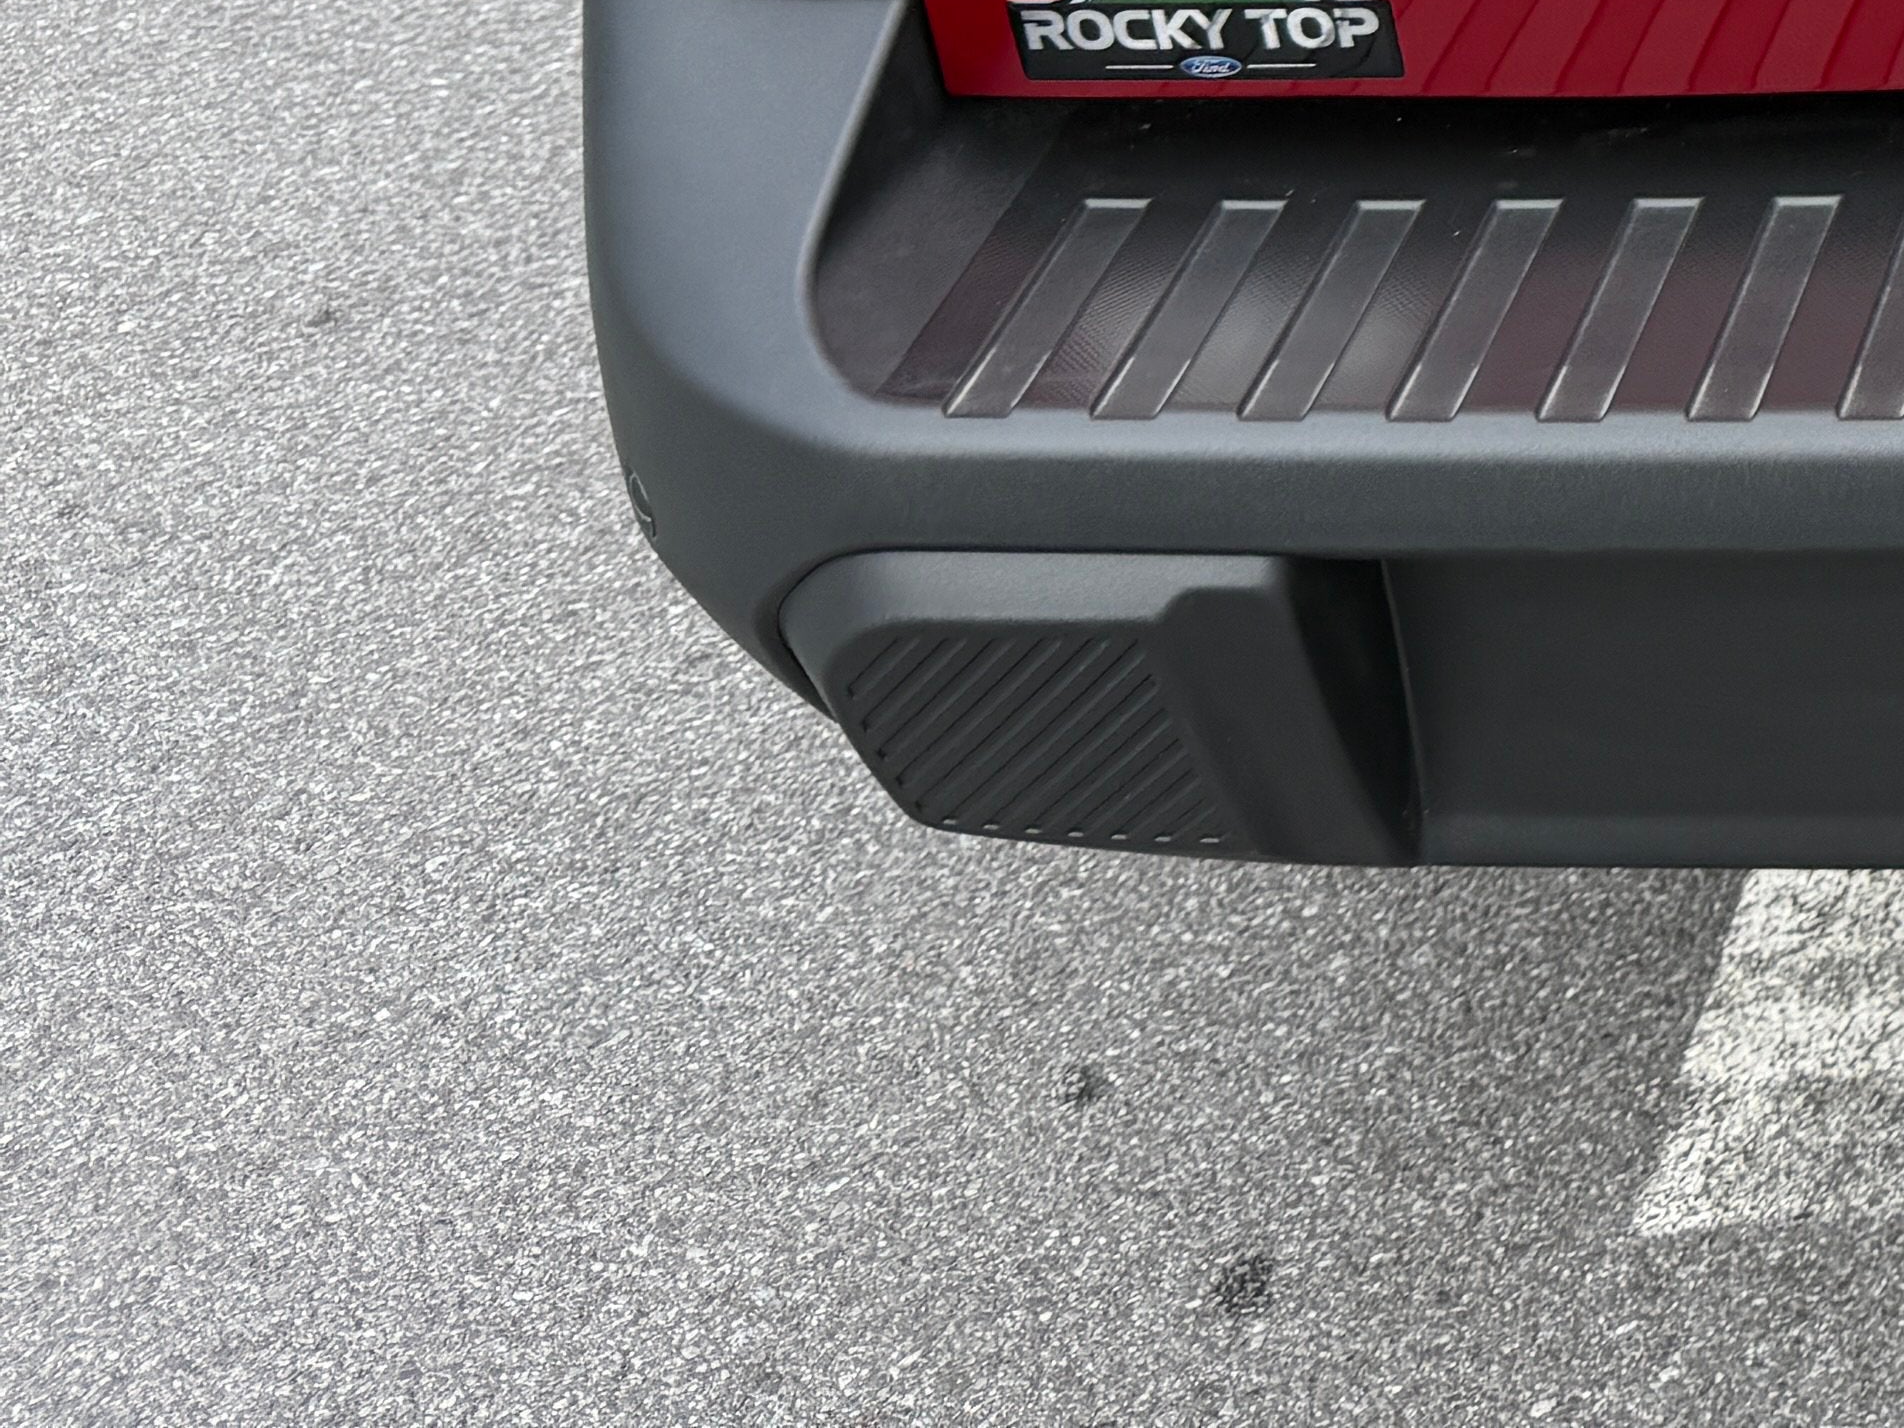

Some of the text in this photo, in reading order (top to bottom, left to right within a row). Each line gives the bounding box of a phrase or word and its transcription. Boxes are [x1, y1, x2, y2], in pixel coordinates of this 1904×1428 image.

[1020, 7, 1380, 51] ROCKY TOP
[1190, 59, 1232, 74] Ford
